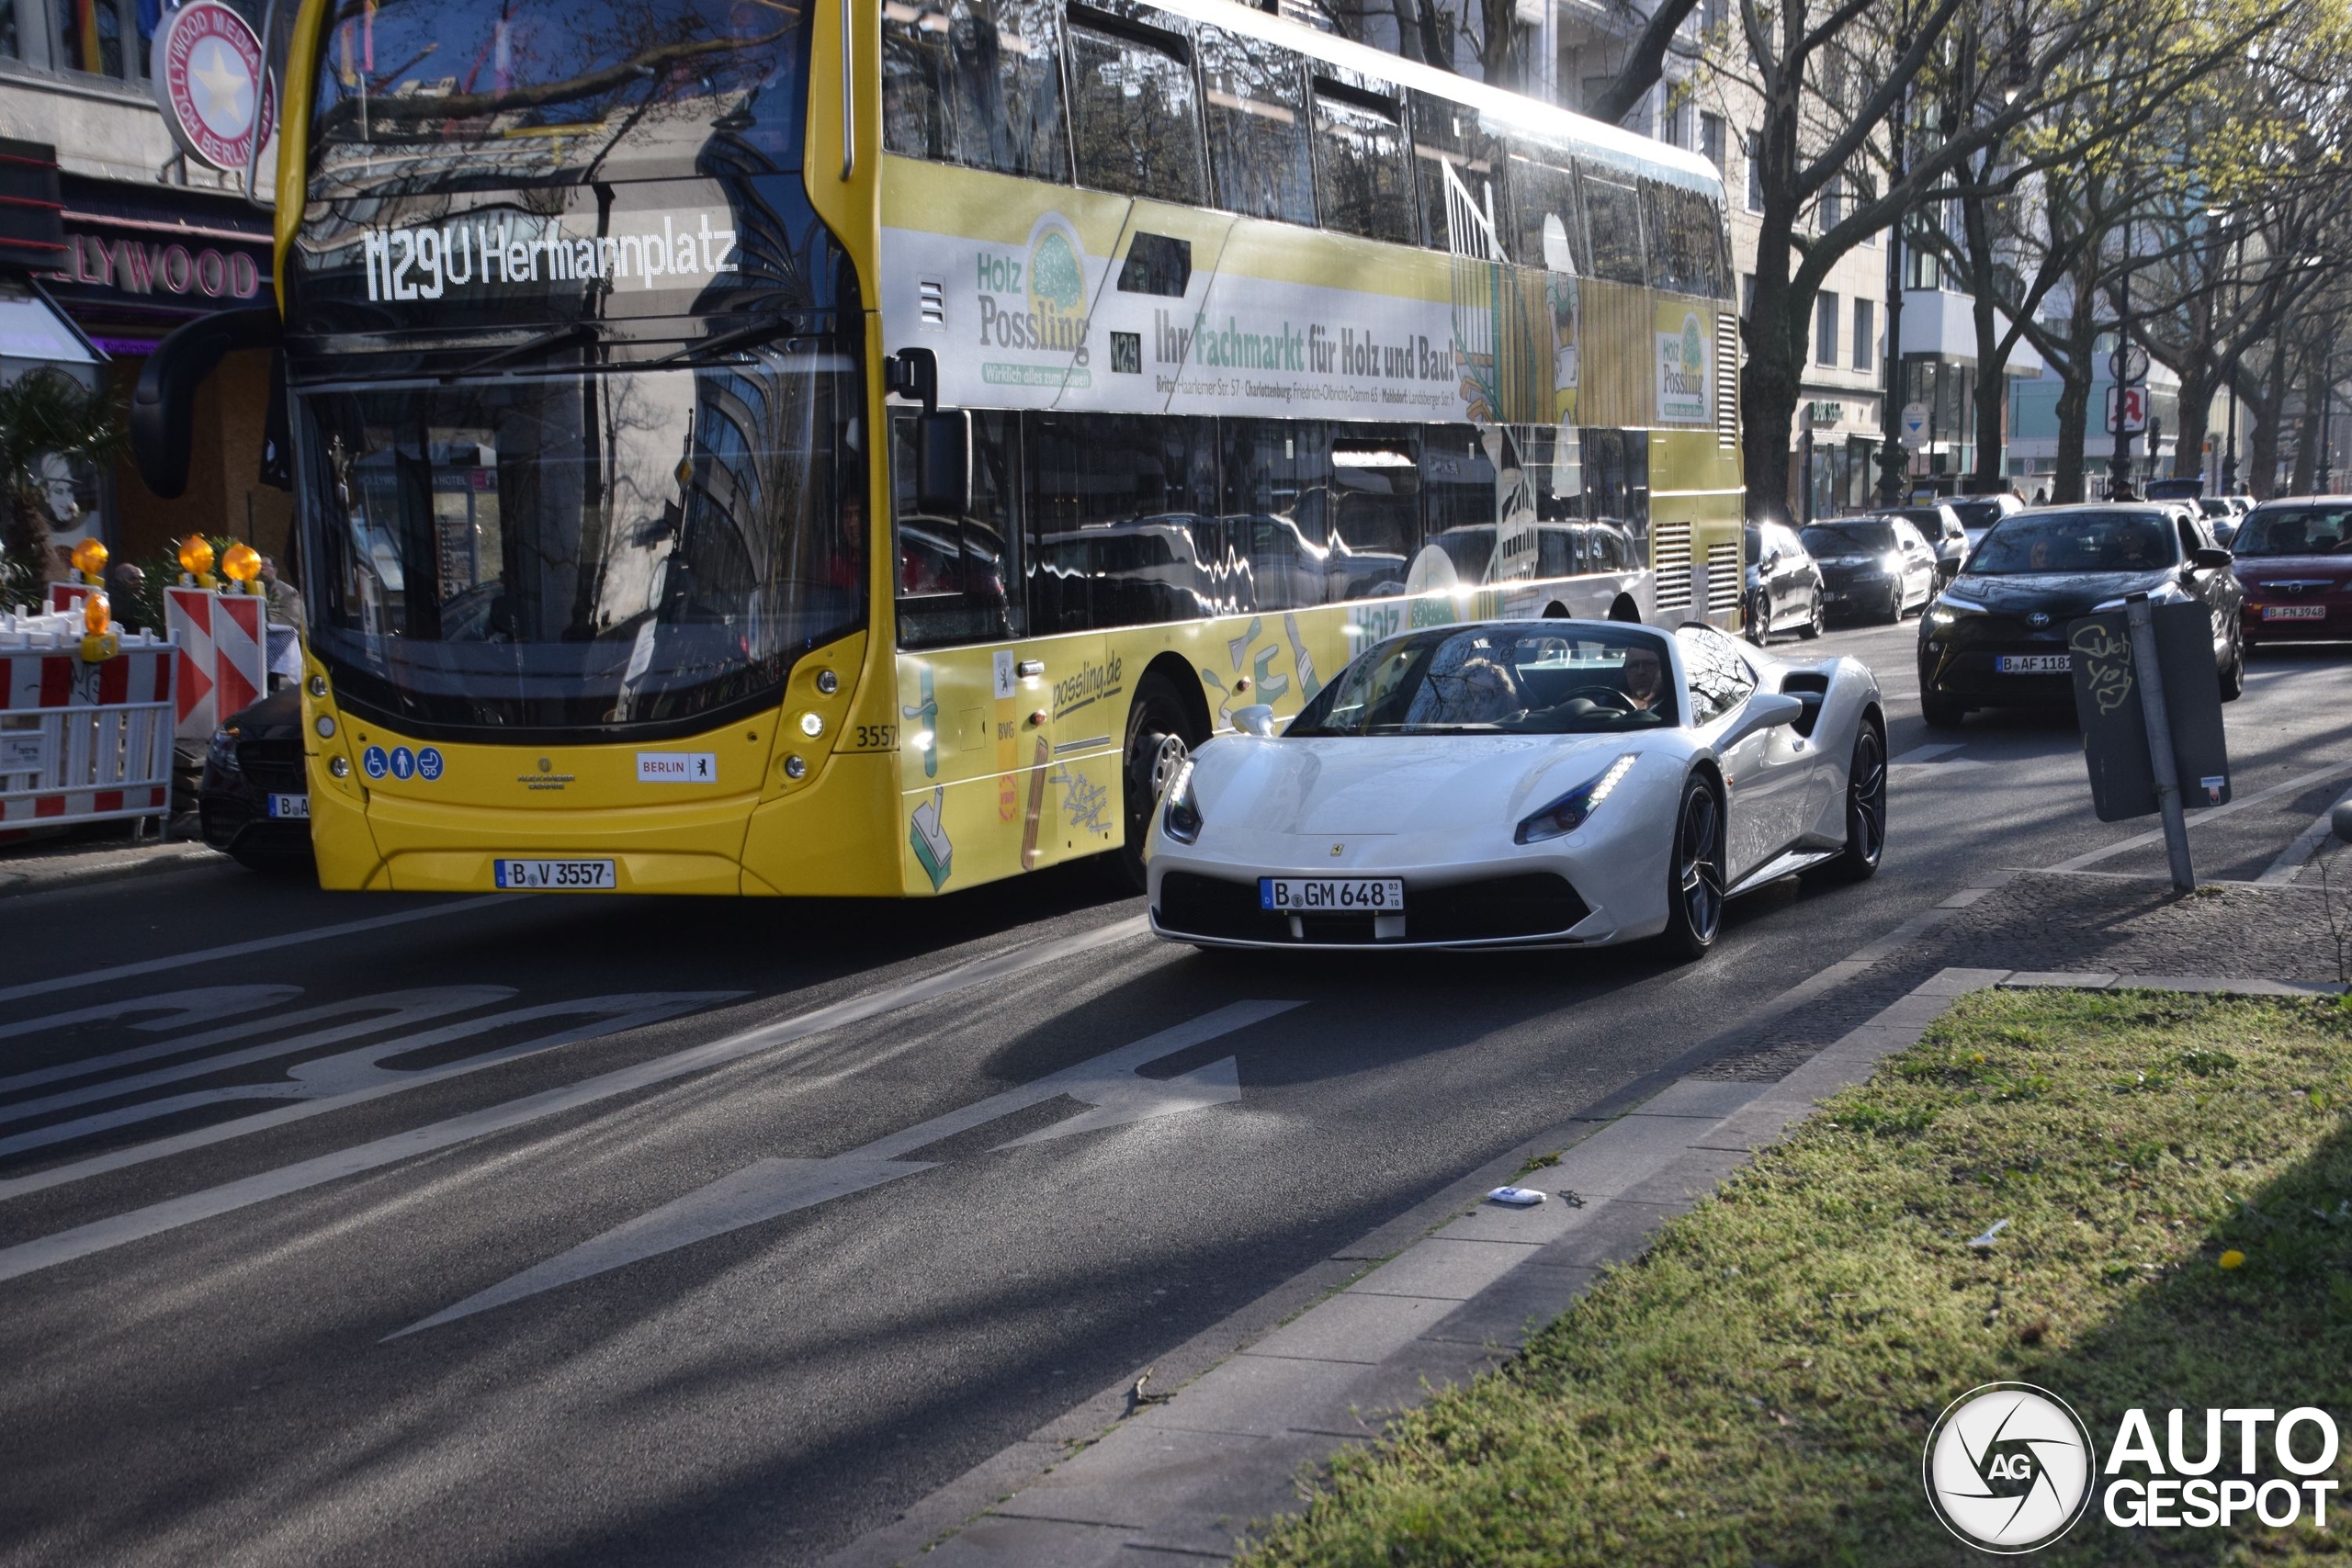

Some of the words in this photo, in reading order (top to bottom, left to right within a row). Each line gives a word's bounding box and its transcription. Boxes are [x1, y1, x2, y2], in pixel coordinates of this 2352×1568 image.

[171, 11, 208, 134] HOLLYWOOD
[212, 11, 258, 69] MEDIA
[29, 234, 258, 299] LYWOOD
[364, 227, 444, 301] M29
[444, 226, 472, 285] U
[479, 213, 739, 288] Hermannplatz
[977, 252, 1022, 294] Holz
[978, 294, 1091, 367] Possling
[1111, 333, 1139, 373] M29
[1155, 309, 1189, 365] Ihr
[1194, 312, 1305, 373] Fachmarkt
[1308, 323, 1336, 374] für
[1341, 327, 1380, 377] Holz
[1384, 334, 1415, 379] und
[1419, 335, 1454, 382] Bau!
[1663, 338, 1679, 362] Holz
[985, 364, 1021, 382] Wirklich
[1024, 367, 1042, 384] alles
[1045, 371, 1061, 386] zum
[1664, 363, 1703, 404] Possling
[1178, 376, 1216, 395] Haarlemer
[1217, 378, 1228, 396] Str.
[1231, 379, 1239, 396] 57
[1371, 387, 1378, 403] 65
[440, 475, 469, 487] HOTEL
[1355, 604, 1399, 655] Holz
[2004, 658, 2012, 670] B
[2021, 658, 2038, 670] AF
[1053, 649, 1122, 724] possling.de
[856, 725, 897, 747] 3557
[998, 721, 1014, 740] BVG
[643, 761, 684, 773] BERLIN
[282, 797, 291, 815] B
[513, 863, 526, 885] B
[538, 863, 550, 885] V
[556, 863, 605, 886] 3557
[1275, 883, 1290, 906] B
[1305, 883, 1335, 906] GM
[1340, 883, 1385, 906] 648
